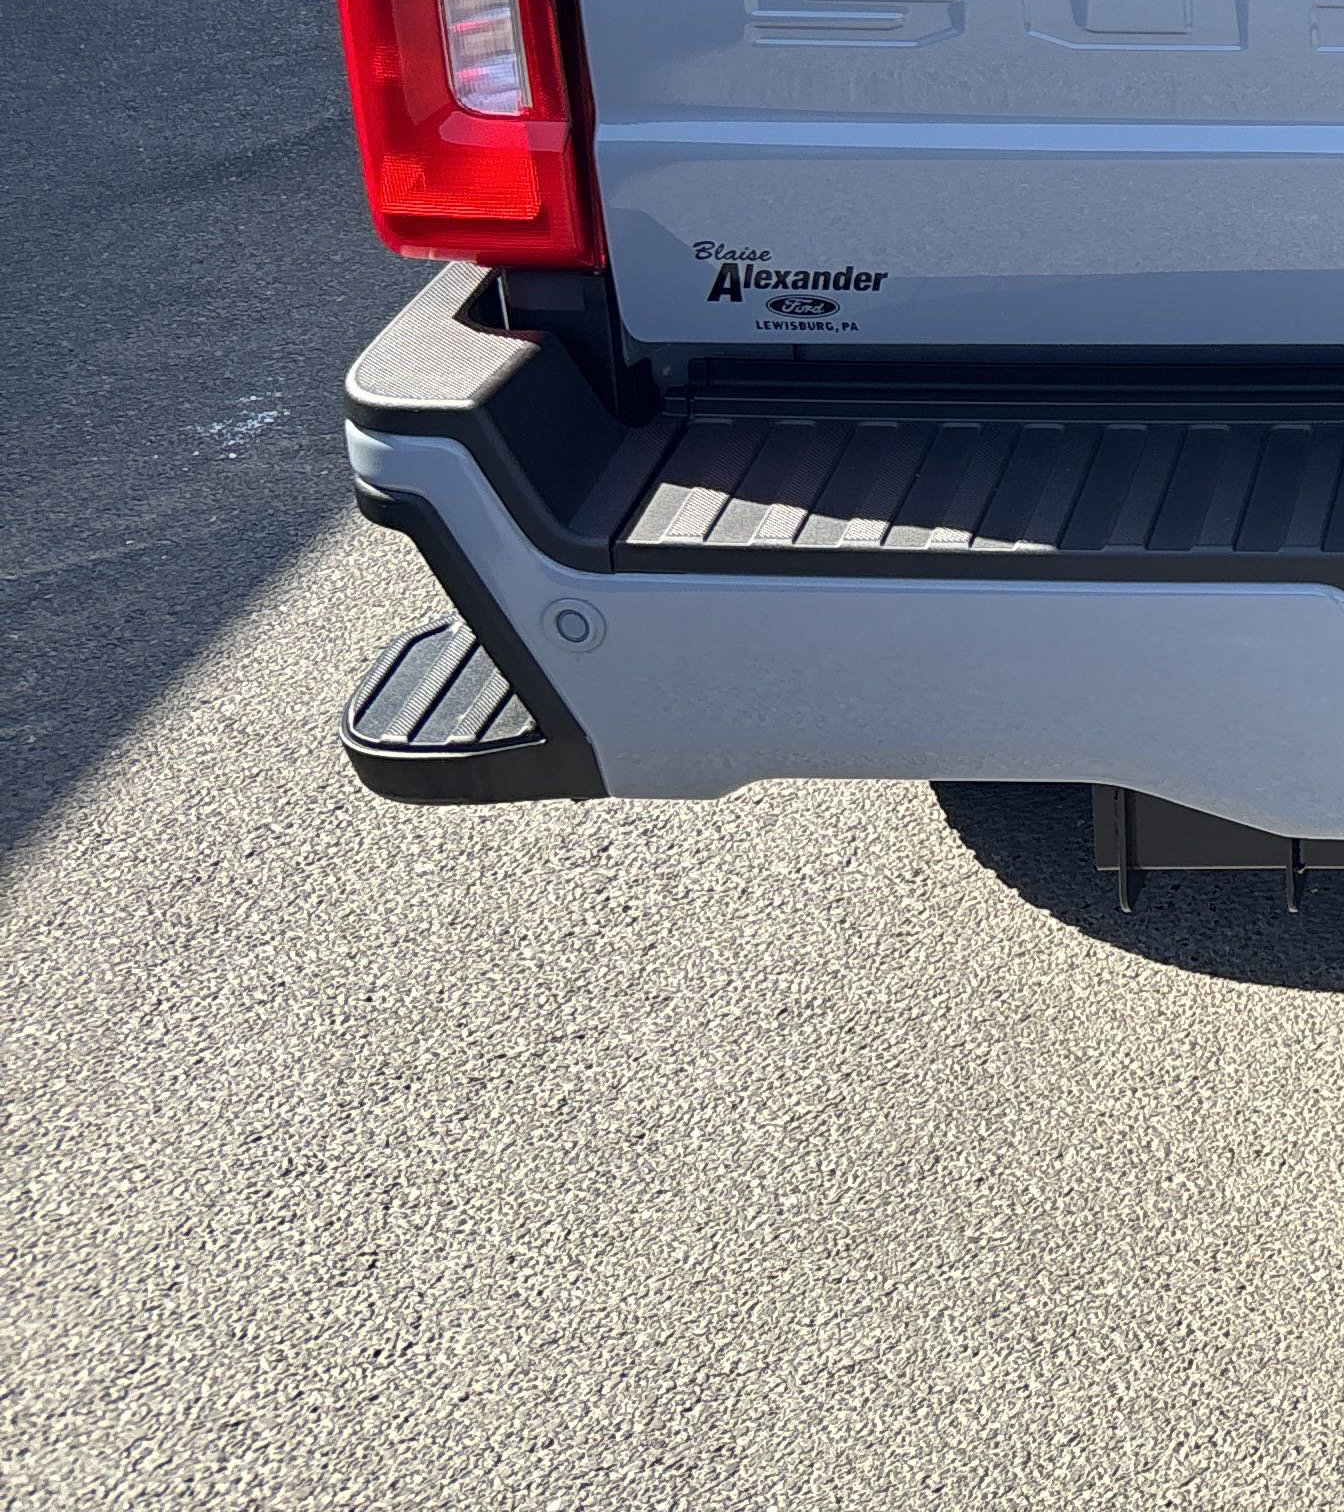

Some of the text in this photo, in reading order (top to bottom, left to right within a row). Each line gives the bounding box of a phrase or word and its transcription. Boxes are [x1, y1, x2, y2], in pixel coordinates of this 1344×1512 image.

[692, 241, 773, 262] Blaise
[707, 263, 888, 303] Alexander
[781, 299, 824, 314] Ford
[756, 320, 859, 334] LEWISBURG, PA
